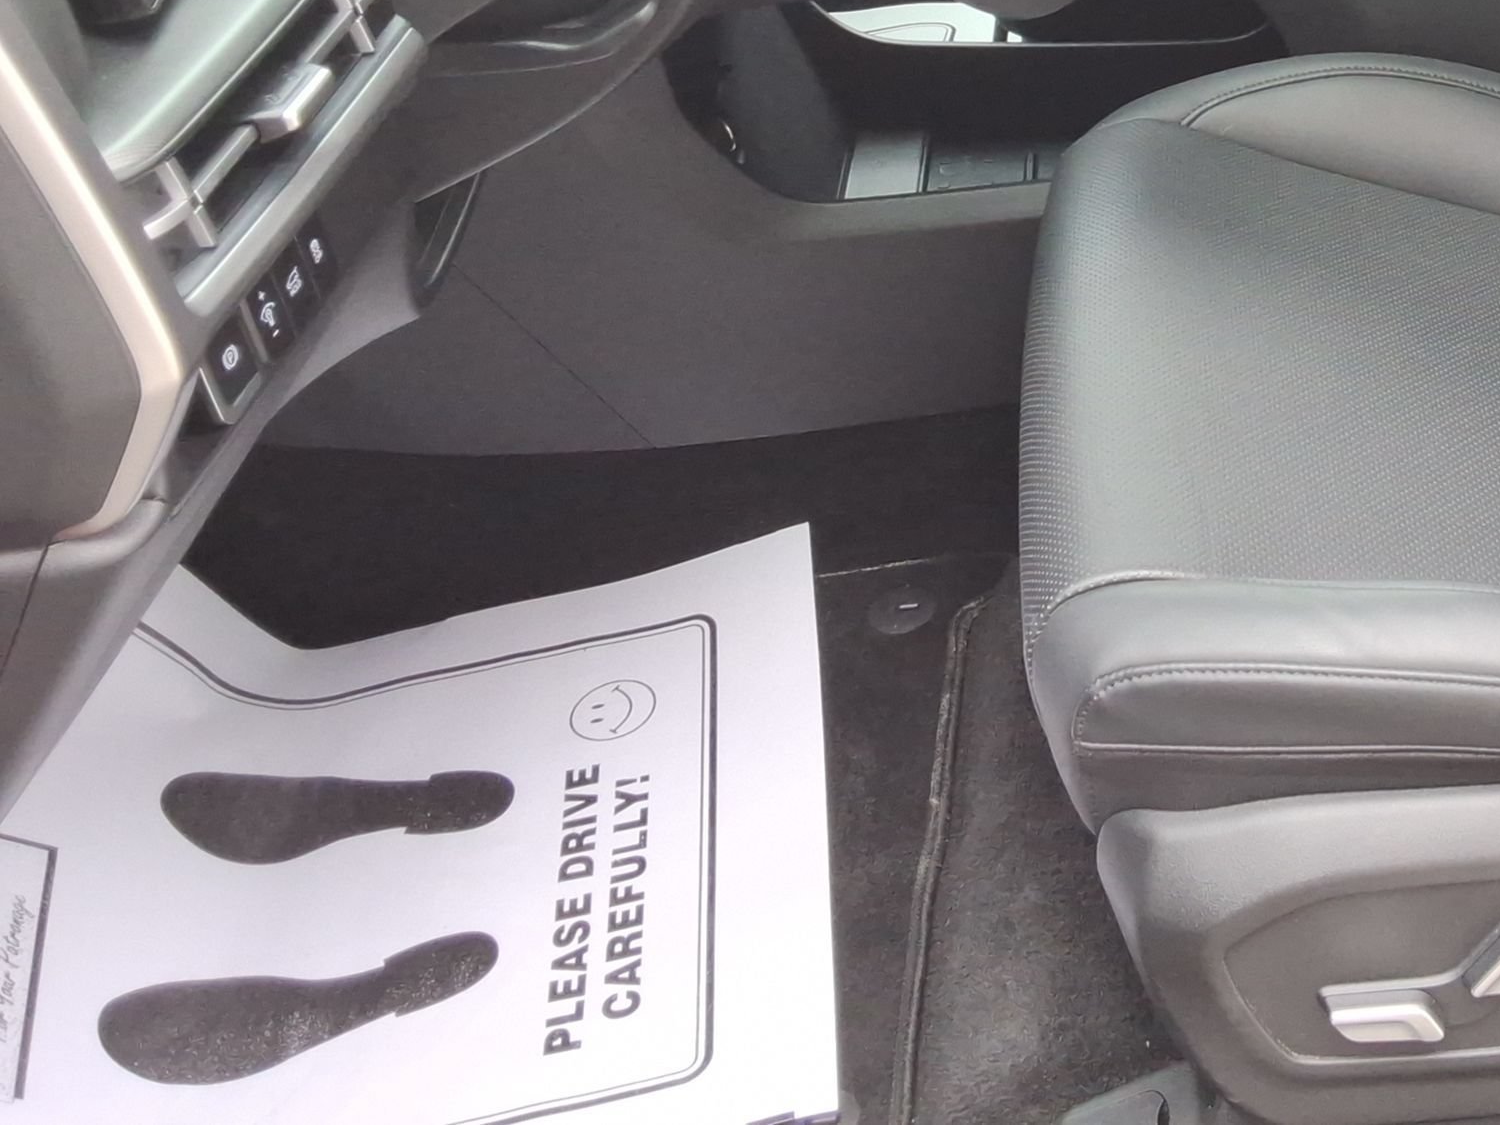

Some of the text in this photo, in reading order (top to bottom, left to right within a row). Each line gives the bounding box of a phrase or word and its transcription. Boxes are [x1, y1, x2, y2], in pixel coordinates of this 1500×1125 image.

[0, 894, 35, 969] Patronage
[543, 763, 600, 1056] PLEASE DRIVE
[601, 774, 650, 1019] CAREFULLY!
